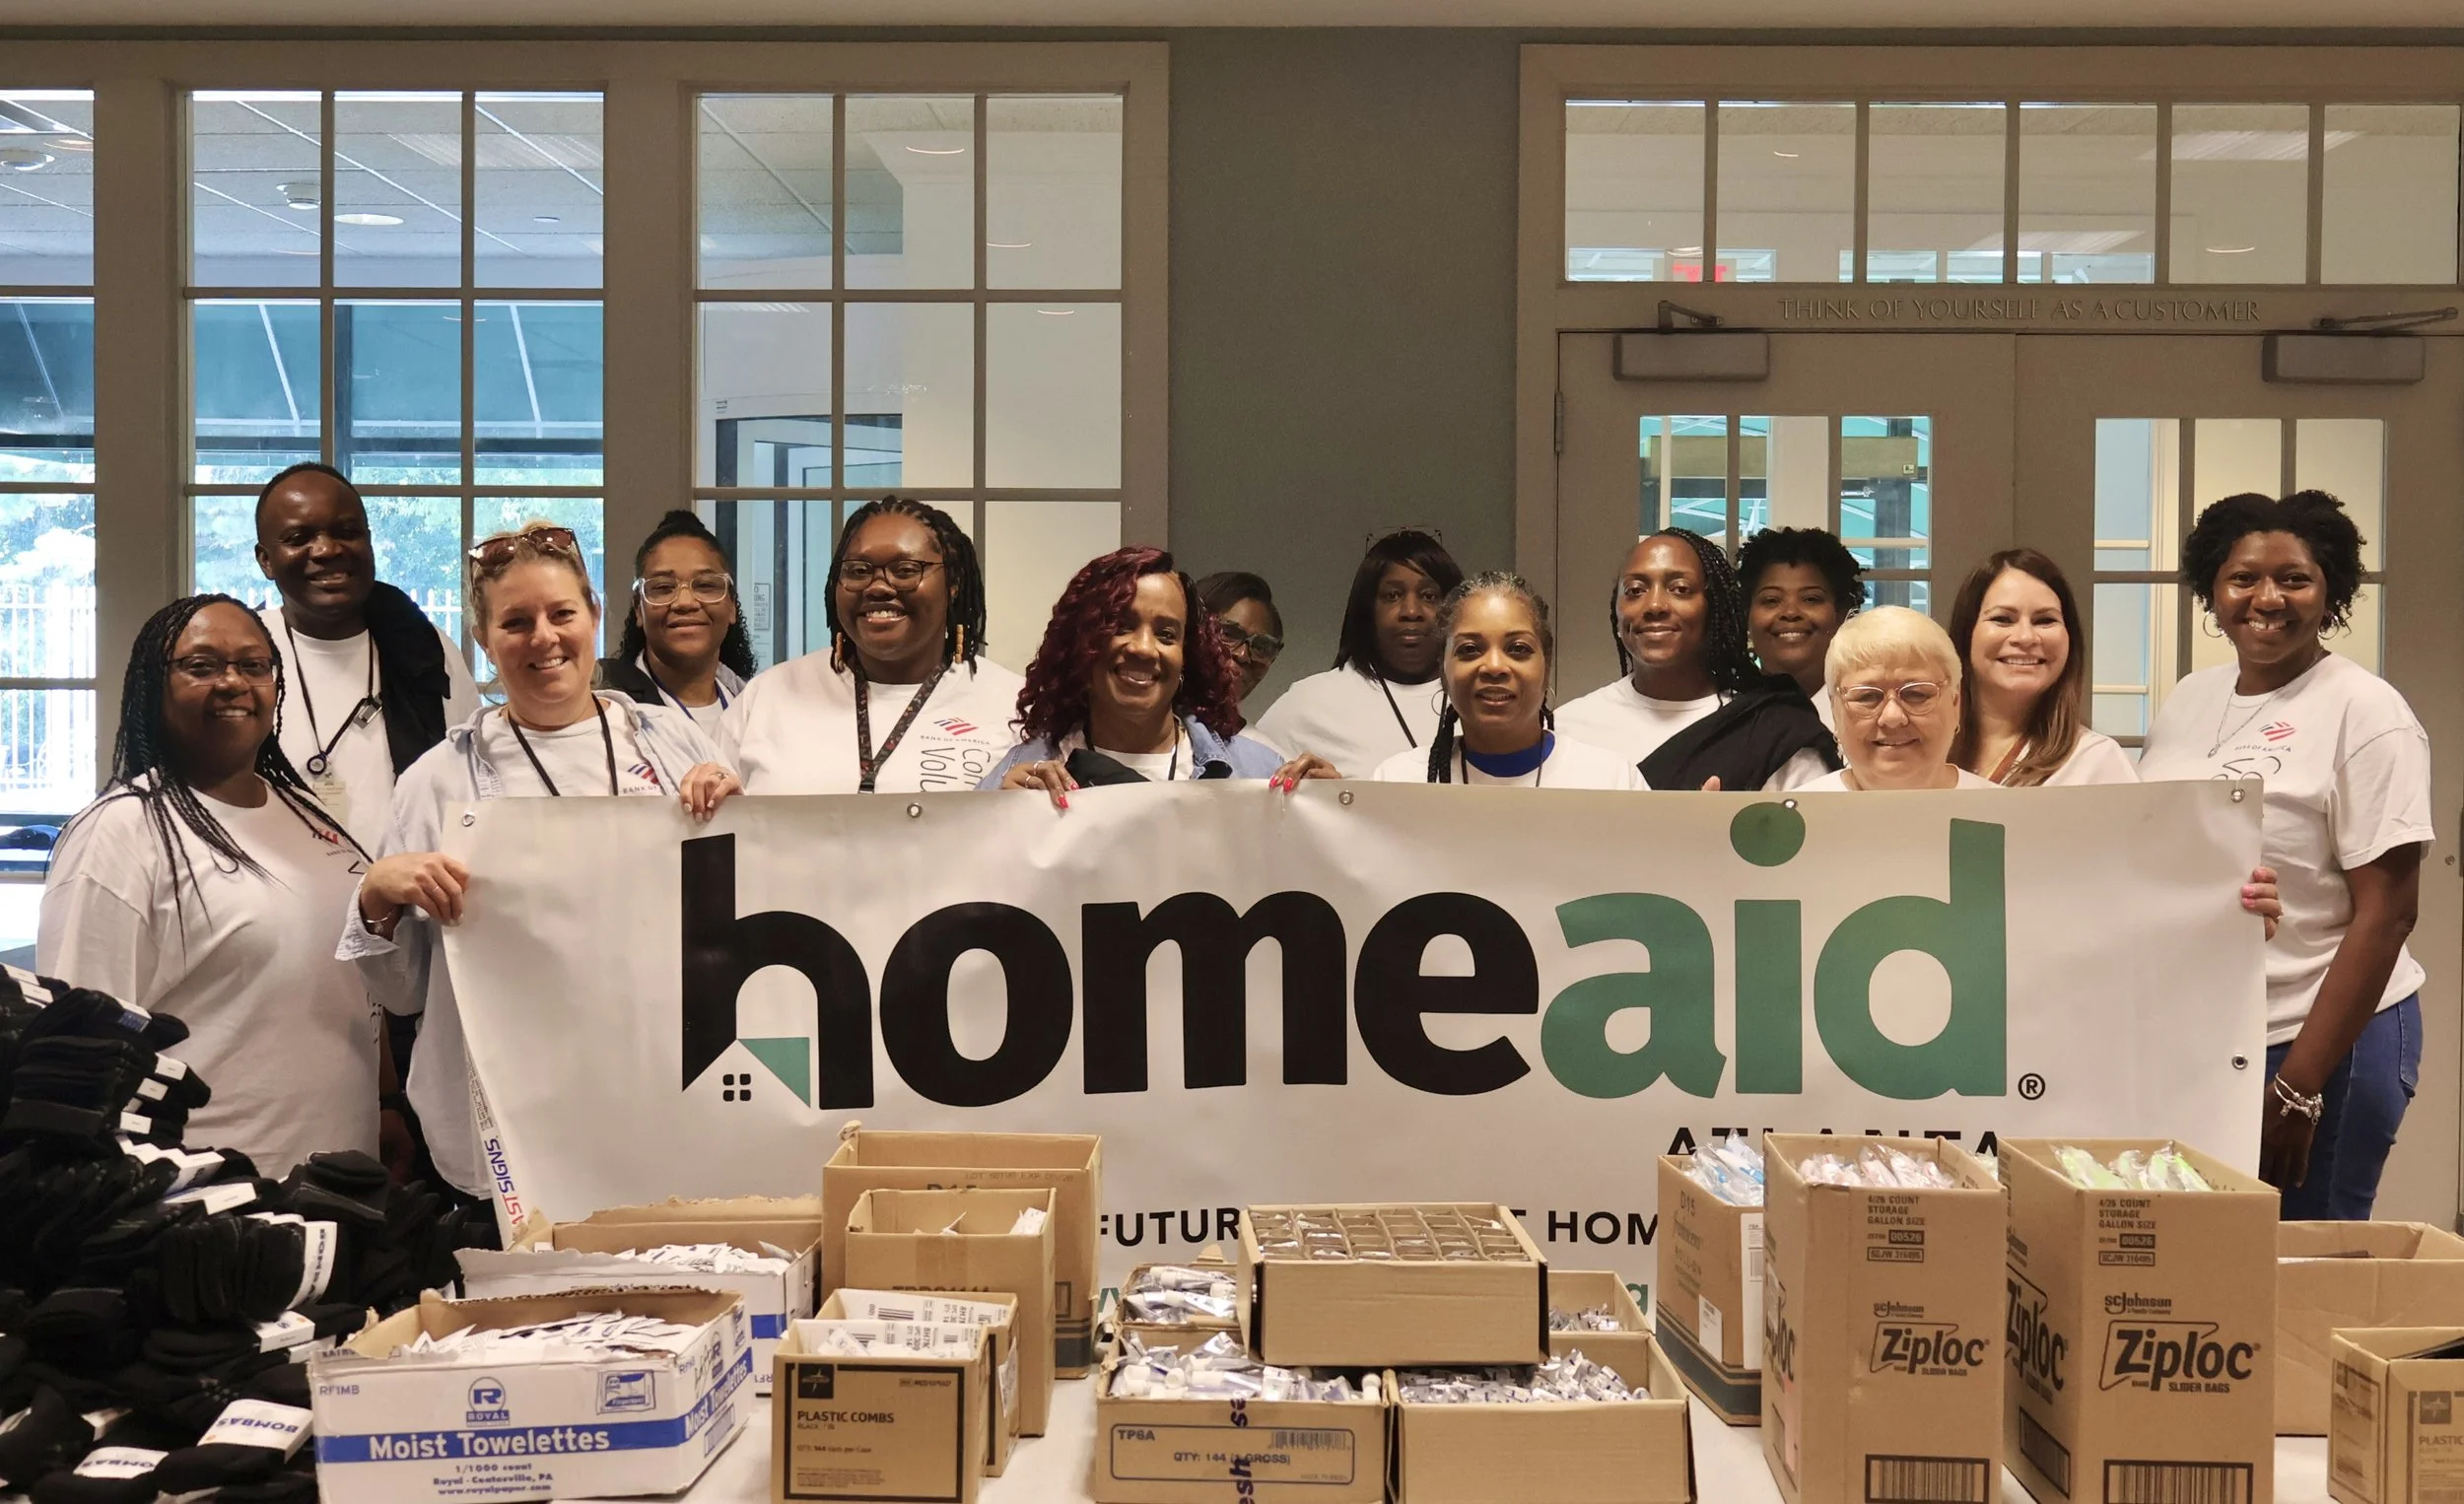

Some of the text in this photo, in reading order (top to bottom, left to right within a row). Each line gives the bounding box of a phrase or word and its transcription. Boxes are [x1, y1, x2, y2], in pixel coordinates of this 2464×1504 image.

[1778, 299, 2260, 321] THINK OF YOURSELF AS A CUSTOMER
[623, 786, 646, 794] BANK
[484, 1138, 524, 1225] ASTSIGNS
[1888, 1195, 1920, 1204] COUNT
[2120, 1198, 2152, 1208] COUNT
[1868, 1205, 1909, 1214] STORAGE
[2098, 1209, 2141, 1218] STORAGE
[1868, 1216, 1903, 1225] GALLON
[2098, 1220, 2134, 1229] GALLON
[1881, 1328, 1985, 1374] Ziploc
[2114, 1329, 2253, 1392] Ziploc
[2168, 1382, 2202, 1393] SLIDER
[2204, 1382, 2230, 1394] BAGS
[685, 1401, 710, 1439] Moist
[709, 1360, 748, 1412] Towelettes
[467, 1411, 509, 1421] ROYAL
[797, 1410, 895, 1424] PLASTIC COMBS
[216, 1416, 300, 1434] BOMBAS
[370, 1429, 611, 1460] Moist Towelettes
[1174, 1452, 1200, 1463] QTY:
[1205, 1453, 1226, 1463] 144
[81, 1459, 156, 1470] OMBAS
[434, 1476, 464, 1486] Royal
[539, 1472, 554, 1481] PA
